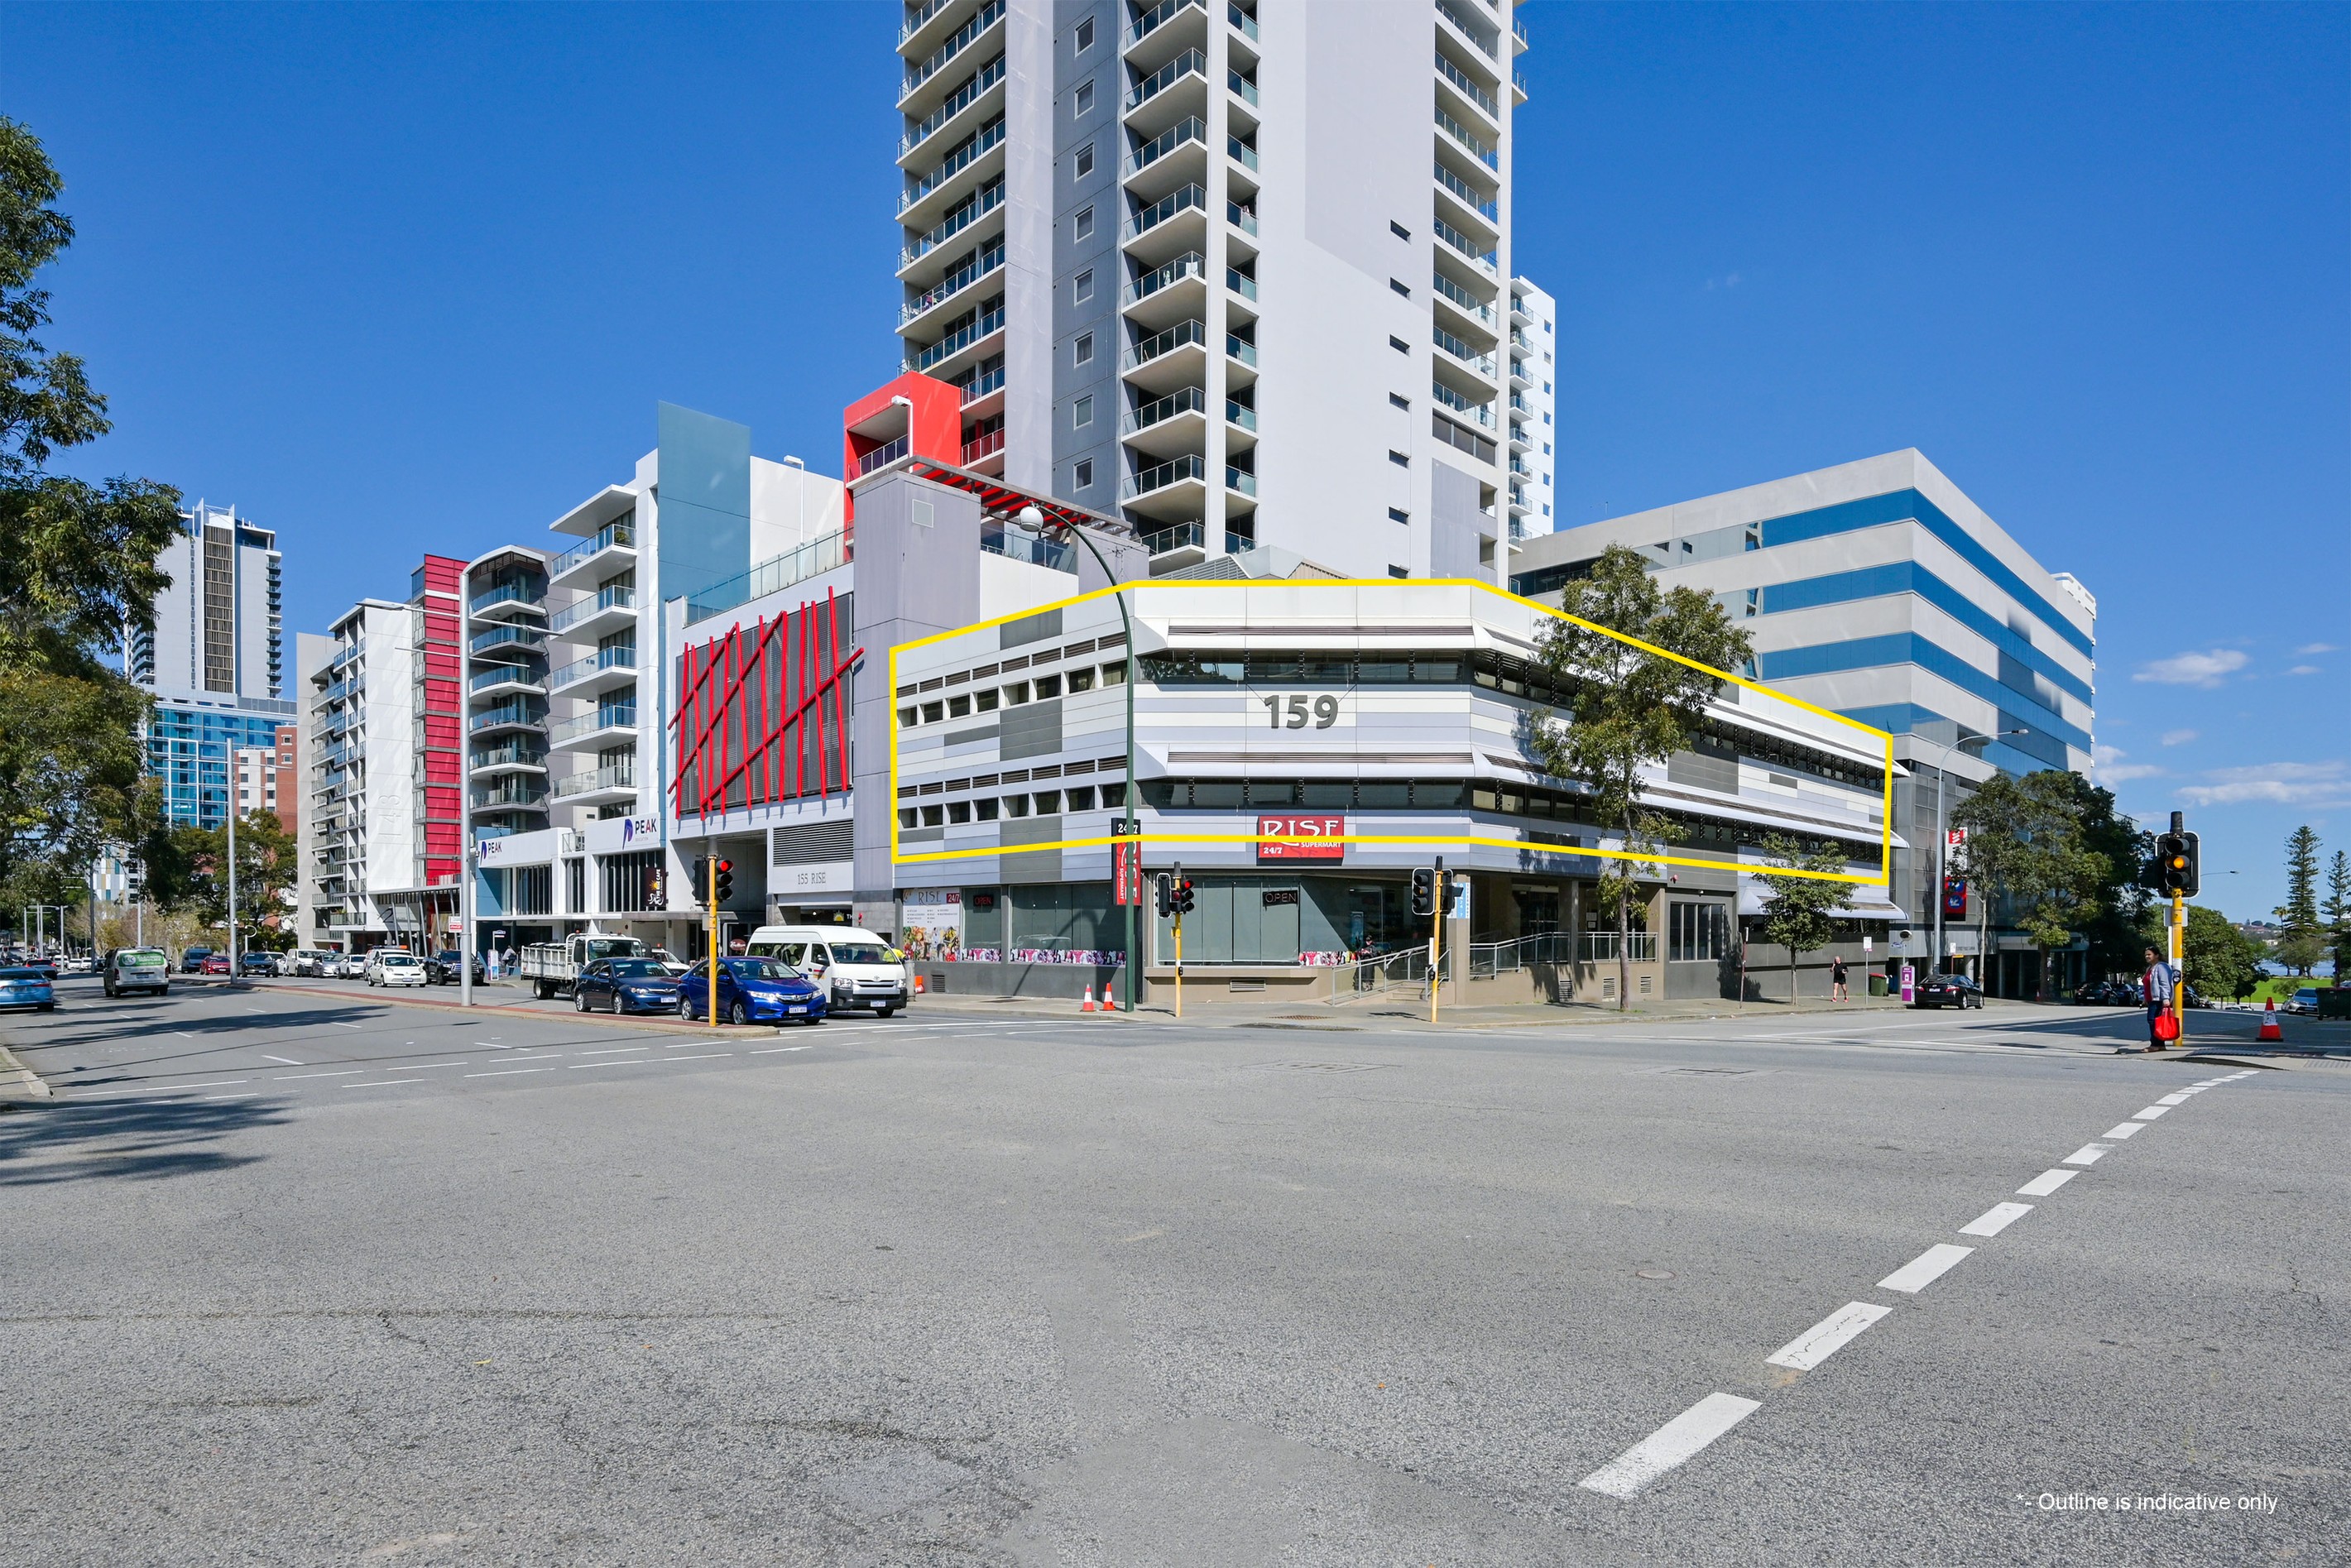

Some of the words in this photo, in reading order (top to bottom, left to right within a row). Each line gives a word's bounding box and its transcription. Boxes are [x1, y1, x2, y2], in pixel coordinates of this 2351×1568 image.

[1264, 694, 1338, 729] 159
[636, 818, 656, 835] PEAK
[1118, 823, 1138, 835] 247
[488, 842, 502, 853] PEAK
[797, 873, 808, 885] 155
[811, 872, 826, 885] RISE
[919, 889, 941, 905] RISE
[948, 894, 960, 903] 24/7
[974, 896, 991, 904] OPEN
[1265, 893, 1296, 903] OPEN
